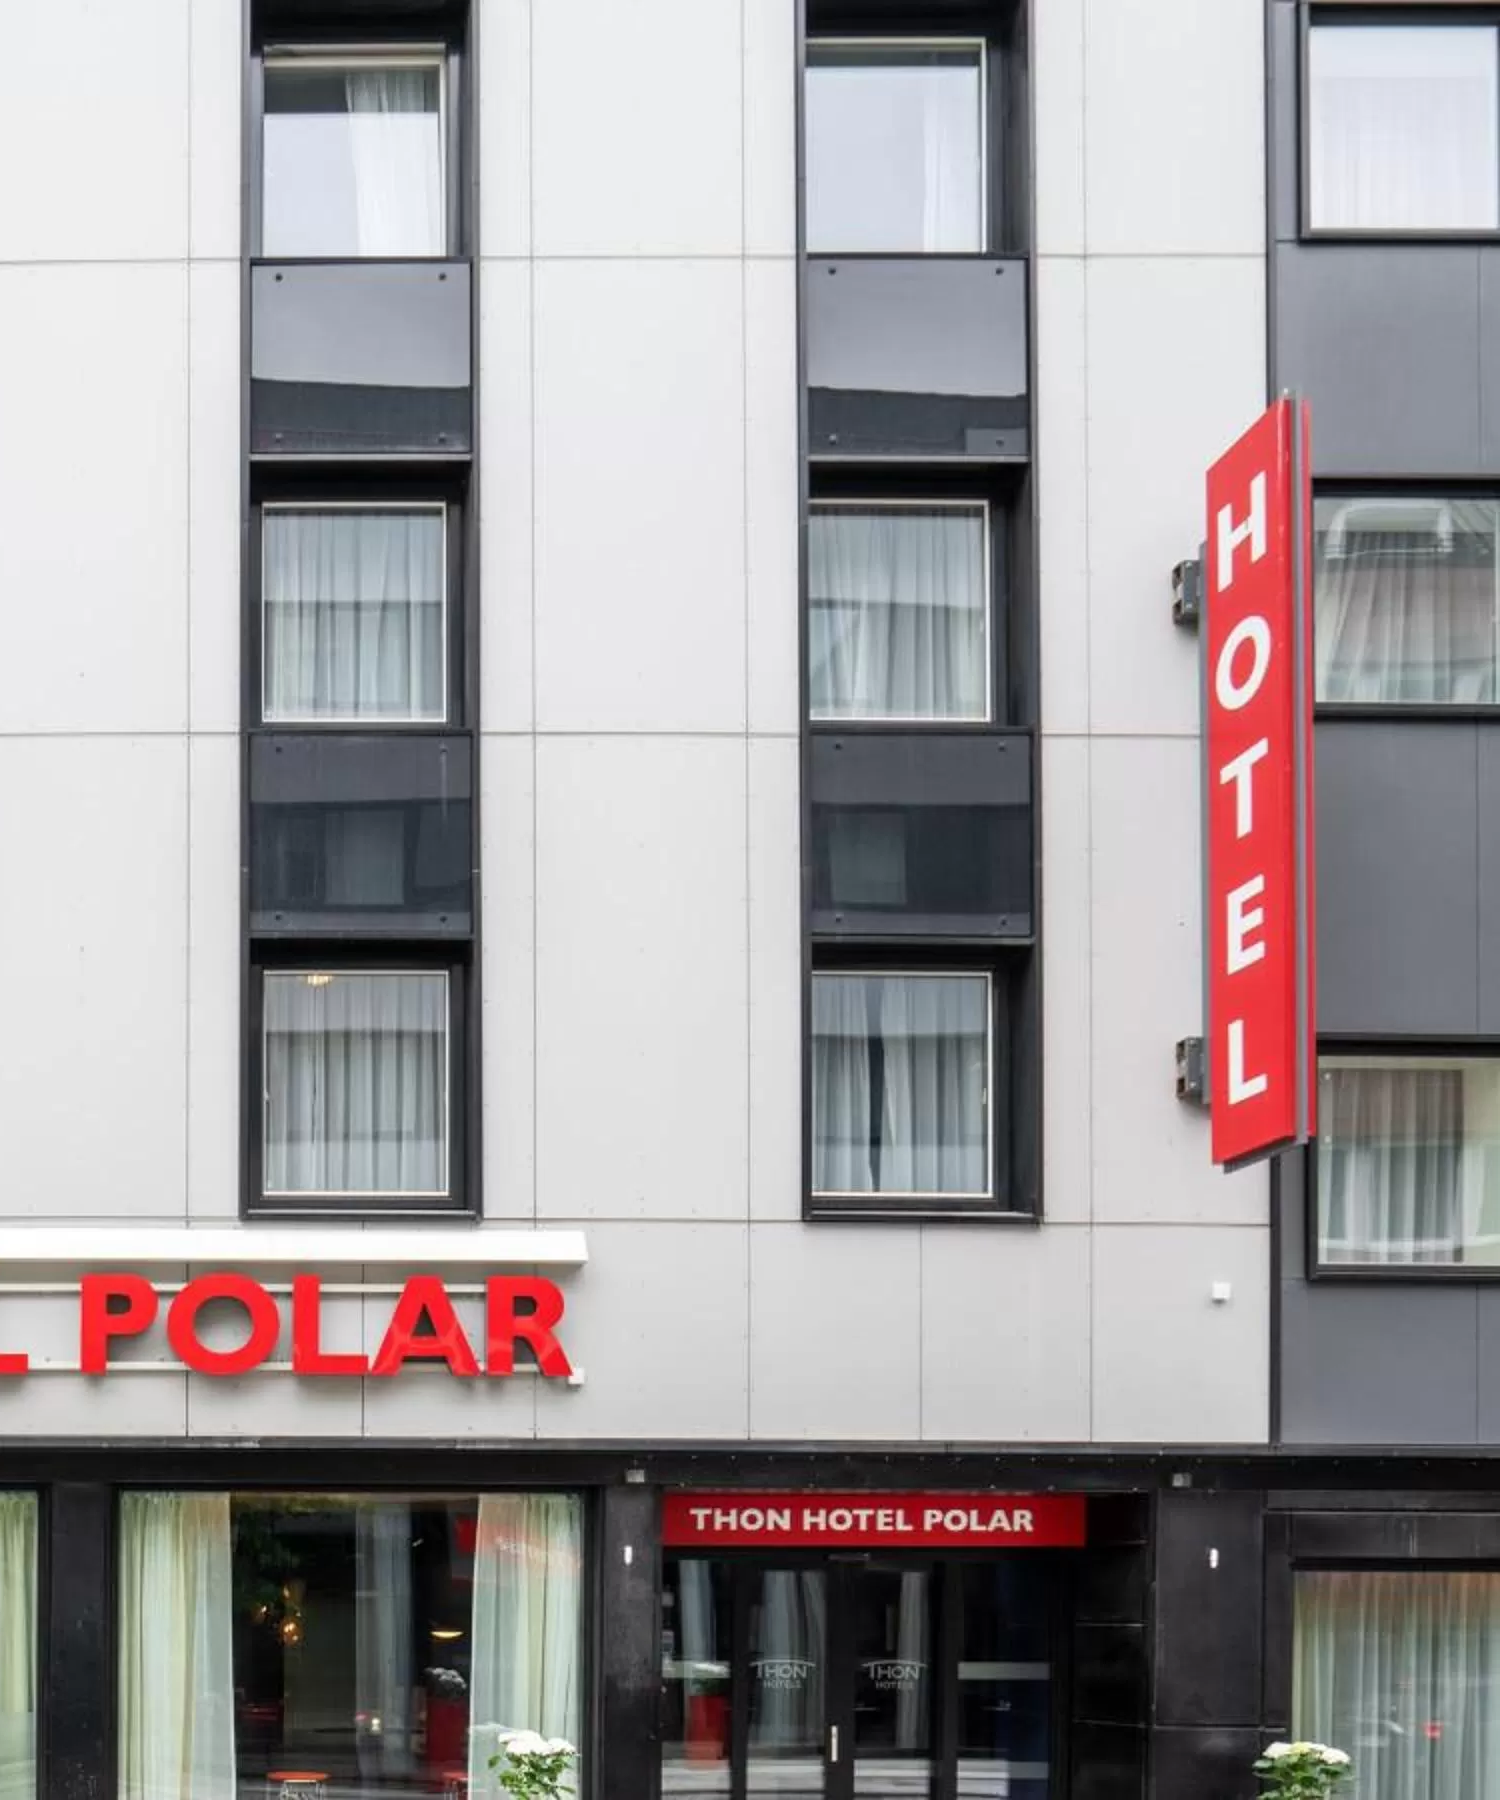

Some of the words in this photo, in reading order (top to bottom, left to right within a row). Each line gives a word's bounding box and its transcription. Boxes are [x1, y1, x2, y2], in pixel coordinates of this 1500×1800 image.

[1216, 471, 1272, 1106] HOTEL
[81, 1273, 572, 1376] POLAR
[690, 1508, 791, 1531] THON
[802, 1508, 913, 1531] HOTEL
[924, 1509, 1033, 1531] POLAR
[751, 1659, 815, 1679] THON
[861, 1660, 927, 1679] THON
